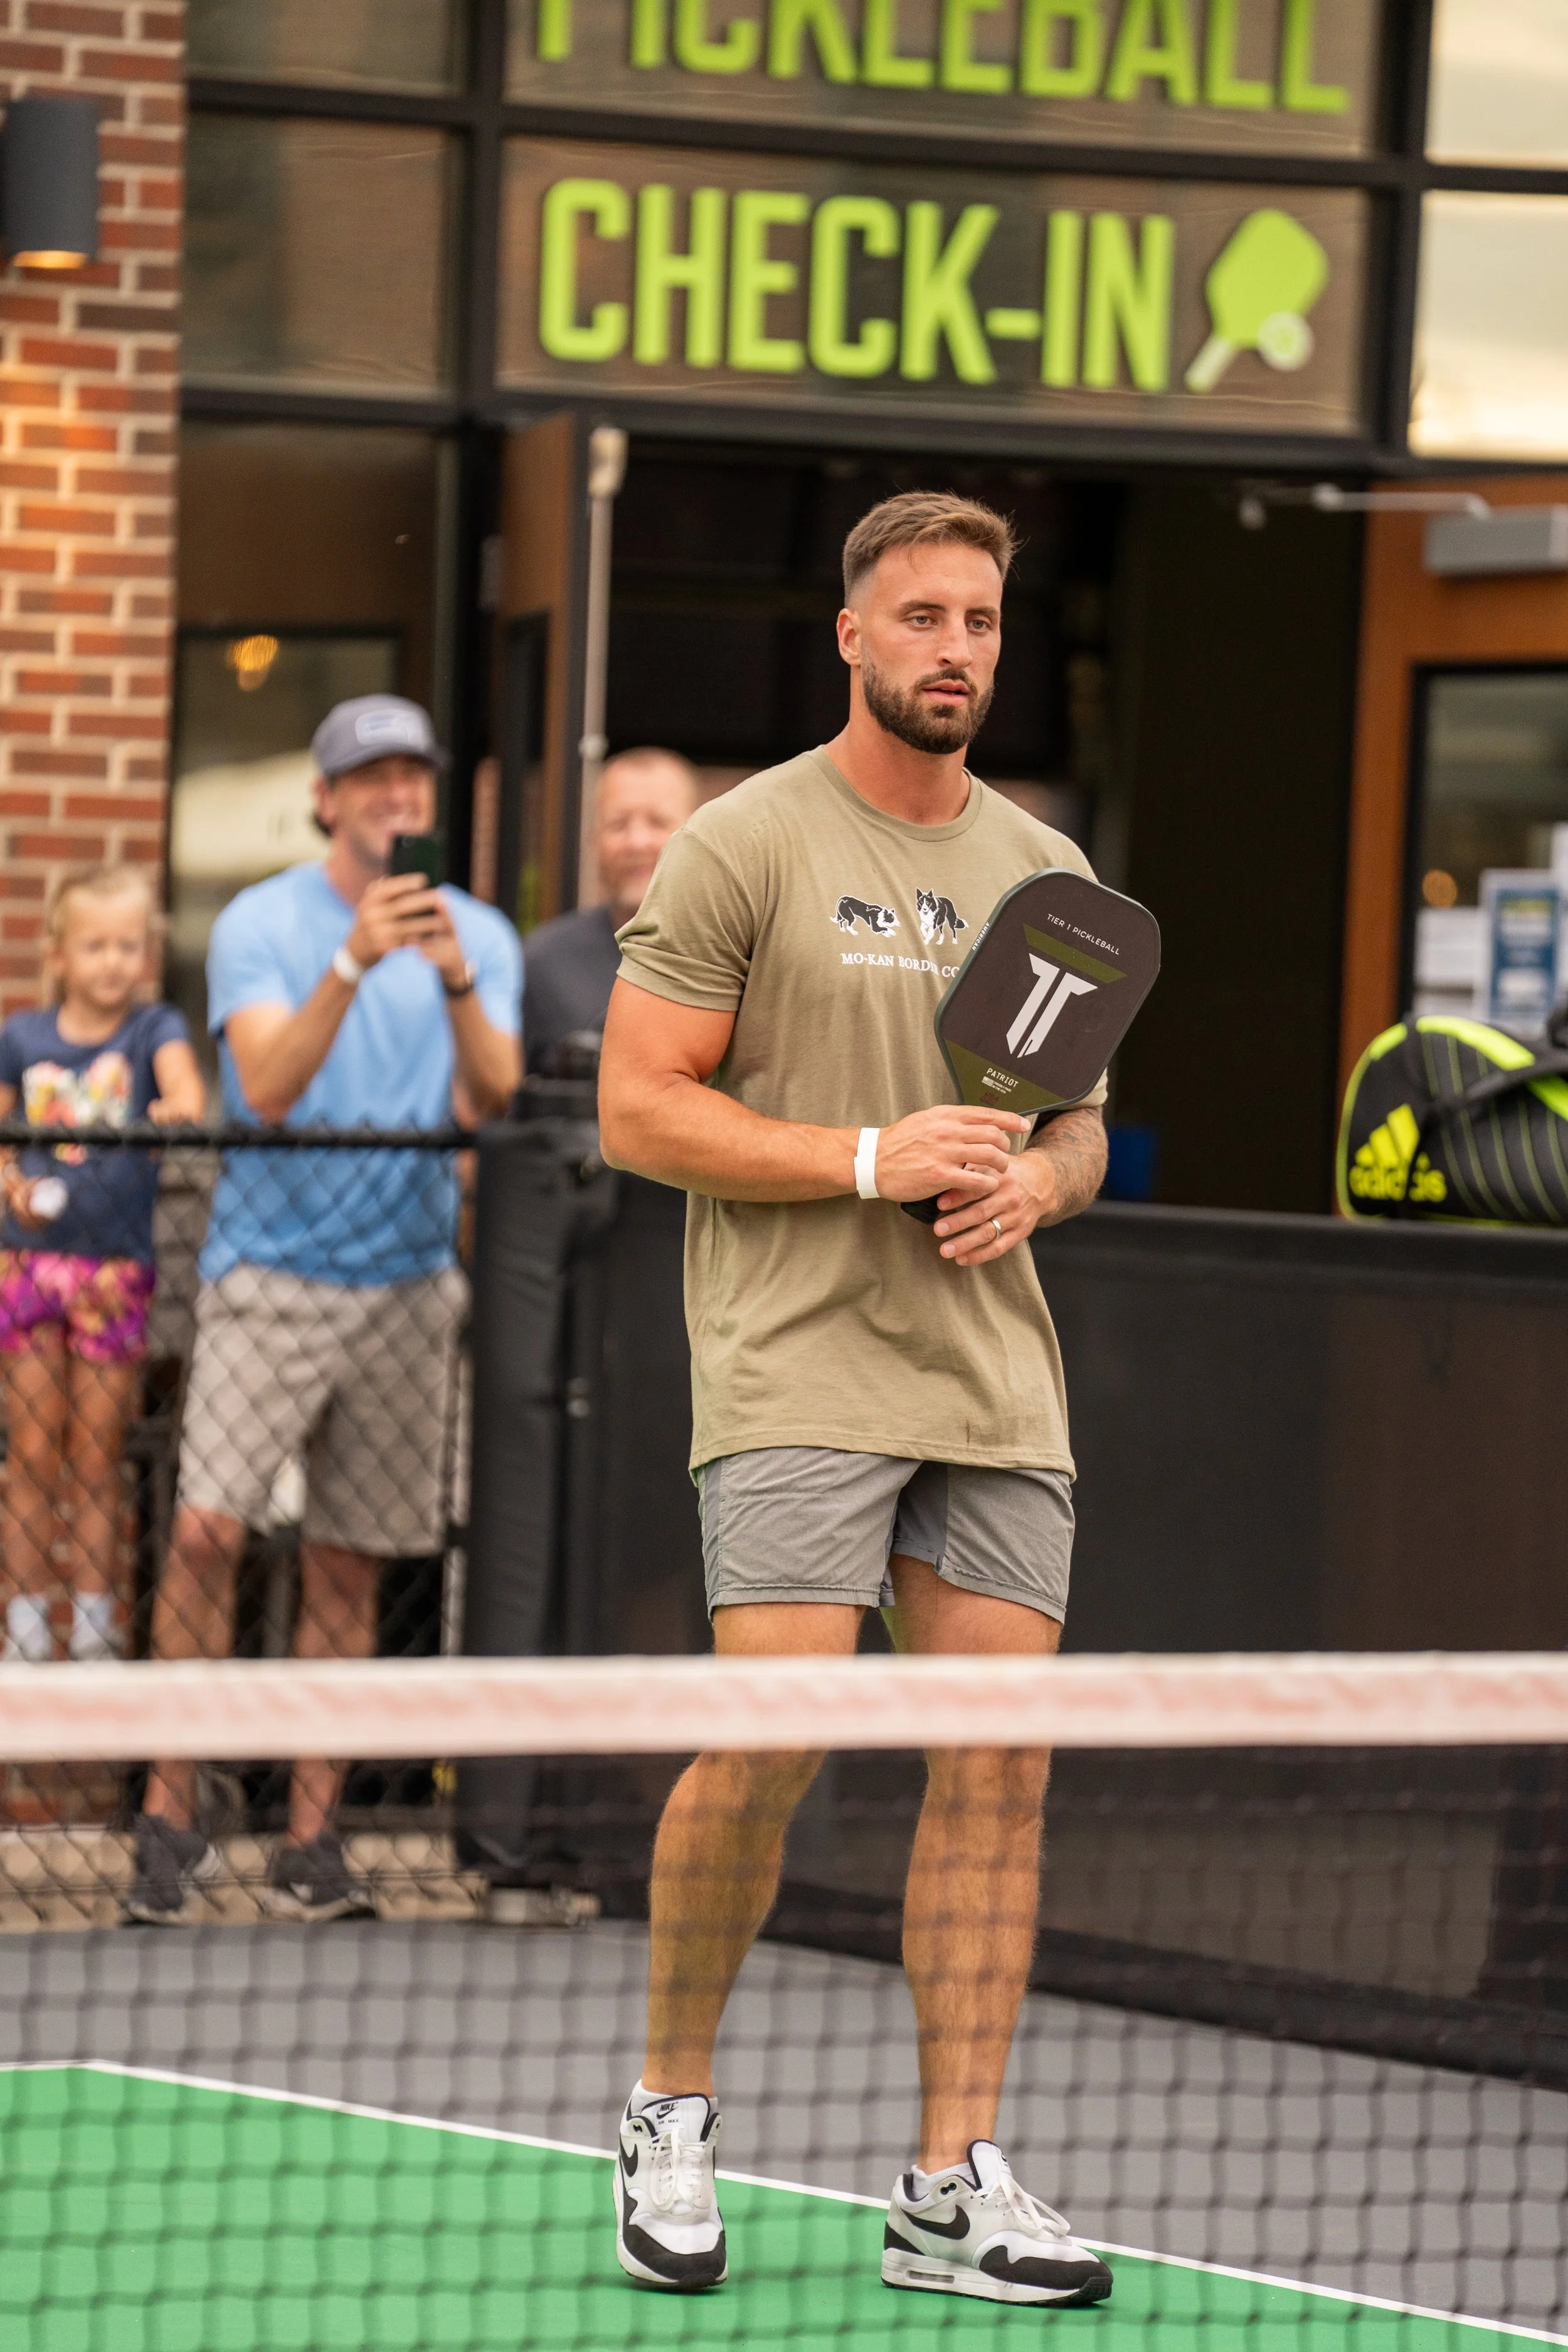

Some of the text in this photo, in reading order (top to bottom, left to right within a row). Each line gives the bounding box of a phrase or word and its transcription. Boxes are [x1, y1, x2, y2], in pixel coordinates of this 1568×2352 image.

[539, 178, 1174, 392] CHECK-IN
[972, 922, 990, 951] AMERICAN
[1047, 913, 1065, 927] TIER
[1072, 927, 1119, 955] PICKLEBALL
[840, 953, 894, 967] MO-KAN
[986, 1067, 1019, 1088] PATRIOT
[660, 2101, 678, 2111] NIKE
